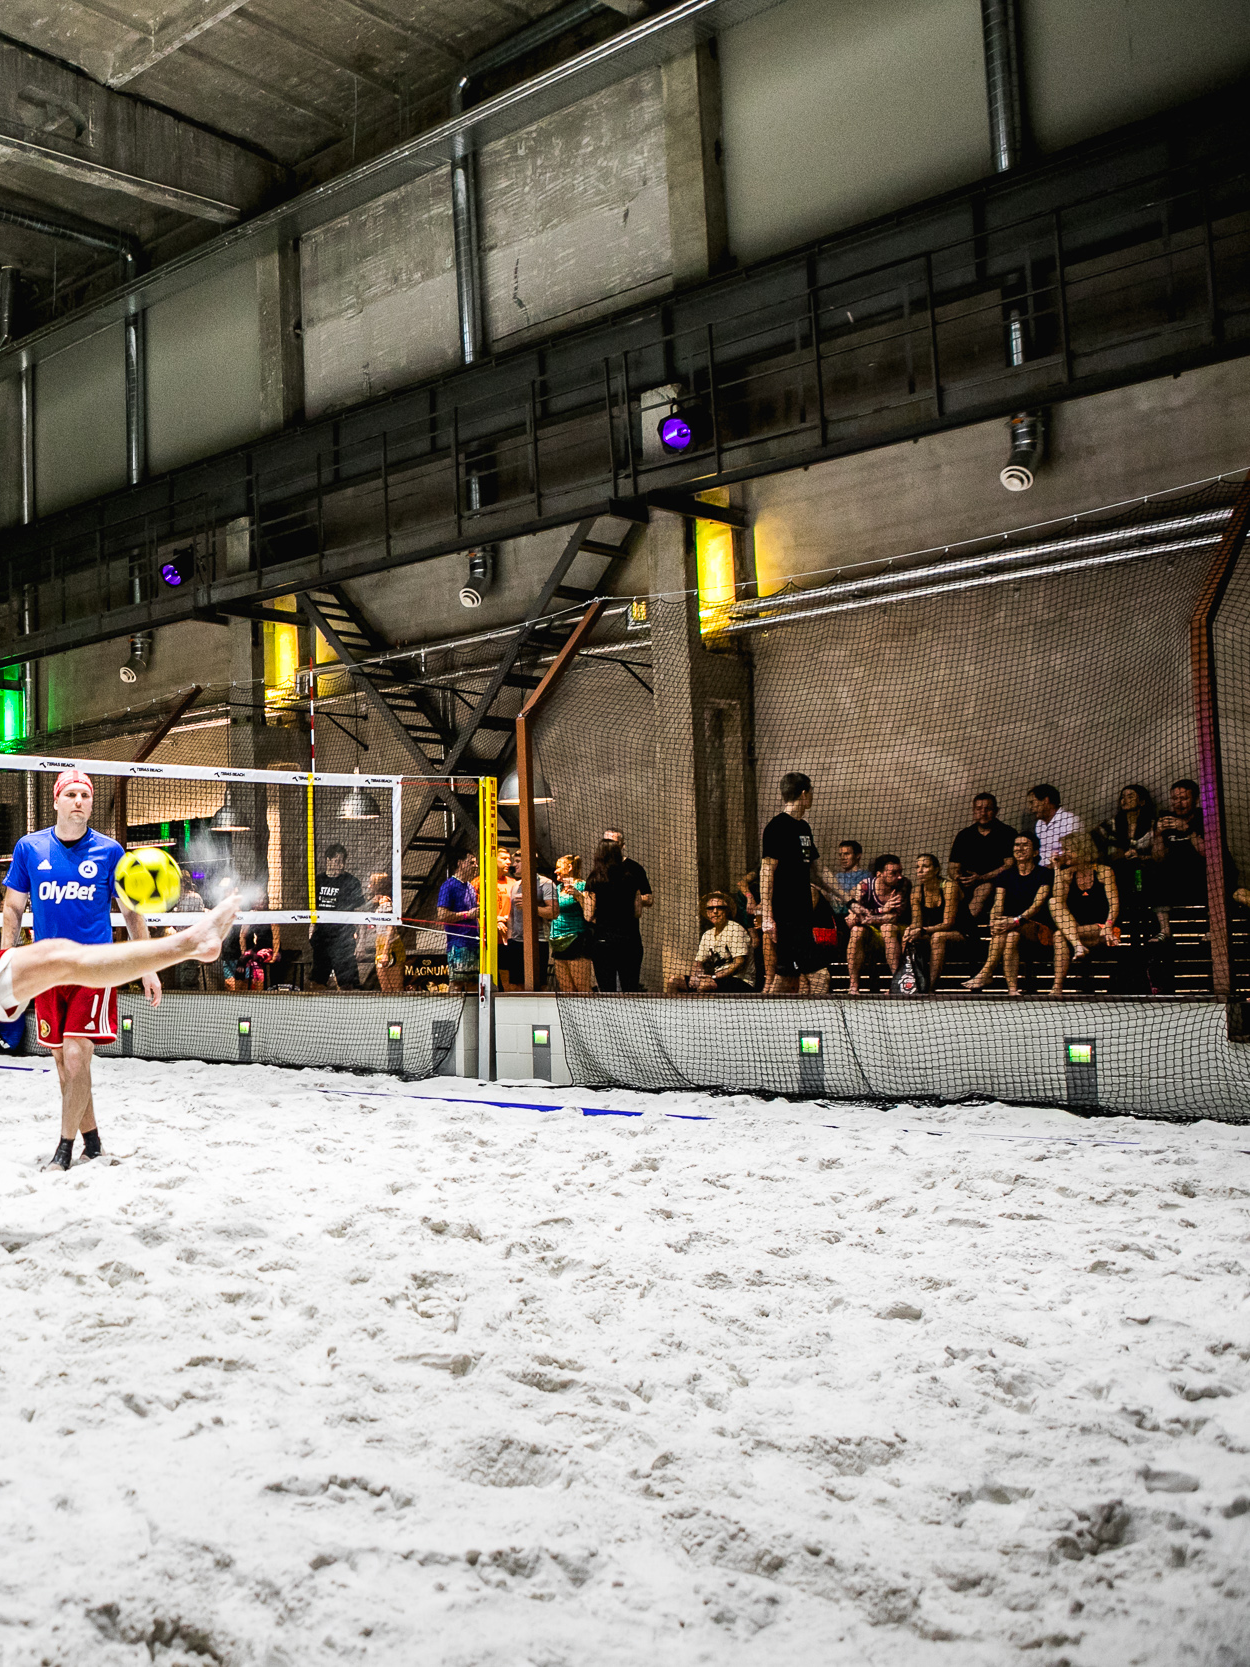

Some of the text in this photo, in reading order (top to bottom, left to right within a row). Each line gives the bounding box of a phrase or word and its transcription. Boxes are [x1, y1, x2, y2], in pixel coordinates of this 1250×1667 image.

[38, 880, 96, 904] OlyBet
[319, 886, 339, 896] STAFF
[404, 964, 449, 976] MAGNUM
